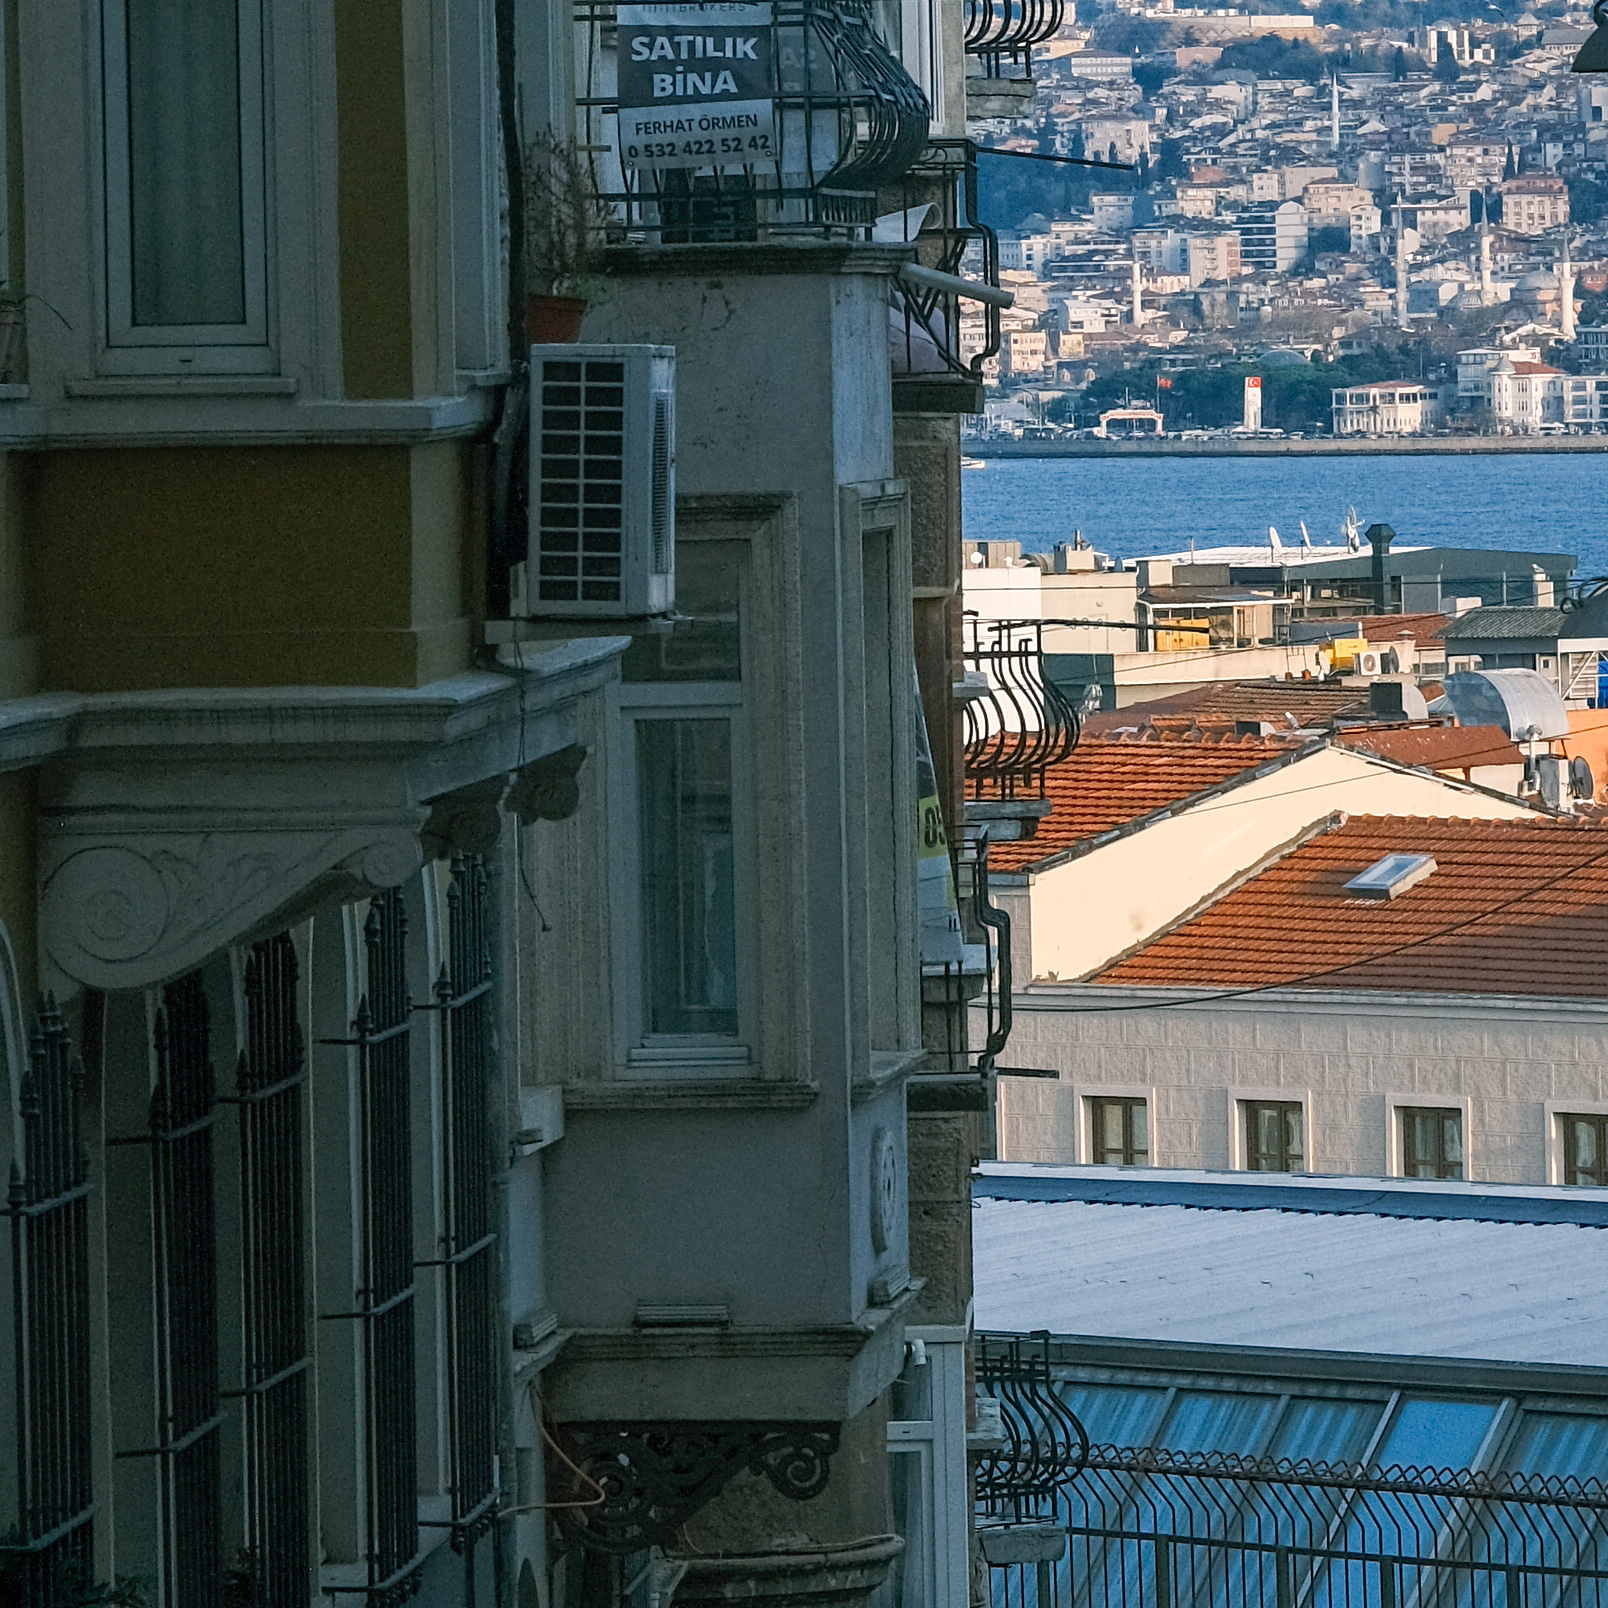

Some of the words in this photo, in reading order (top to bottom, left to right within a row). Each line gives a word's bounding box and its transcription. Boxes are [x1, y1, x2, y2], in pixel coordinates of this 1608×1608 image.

[631, 35, 759, 62] SATILIK
[653, 65, 739, 98] BİNA
[635, 118, 695, 136] FERHAT
[698, 113, 759, 132] ÖRMEN
[628, 145, 639, 158] 0
[644, 142, 678, 158] 532
[682, 139, 716, 156] 422
[721, 137, 744, 153] 52
[748, 134, 770, 151] 42
